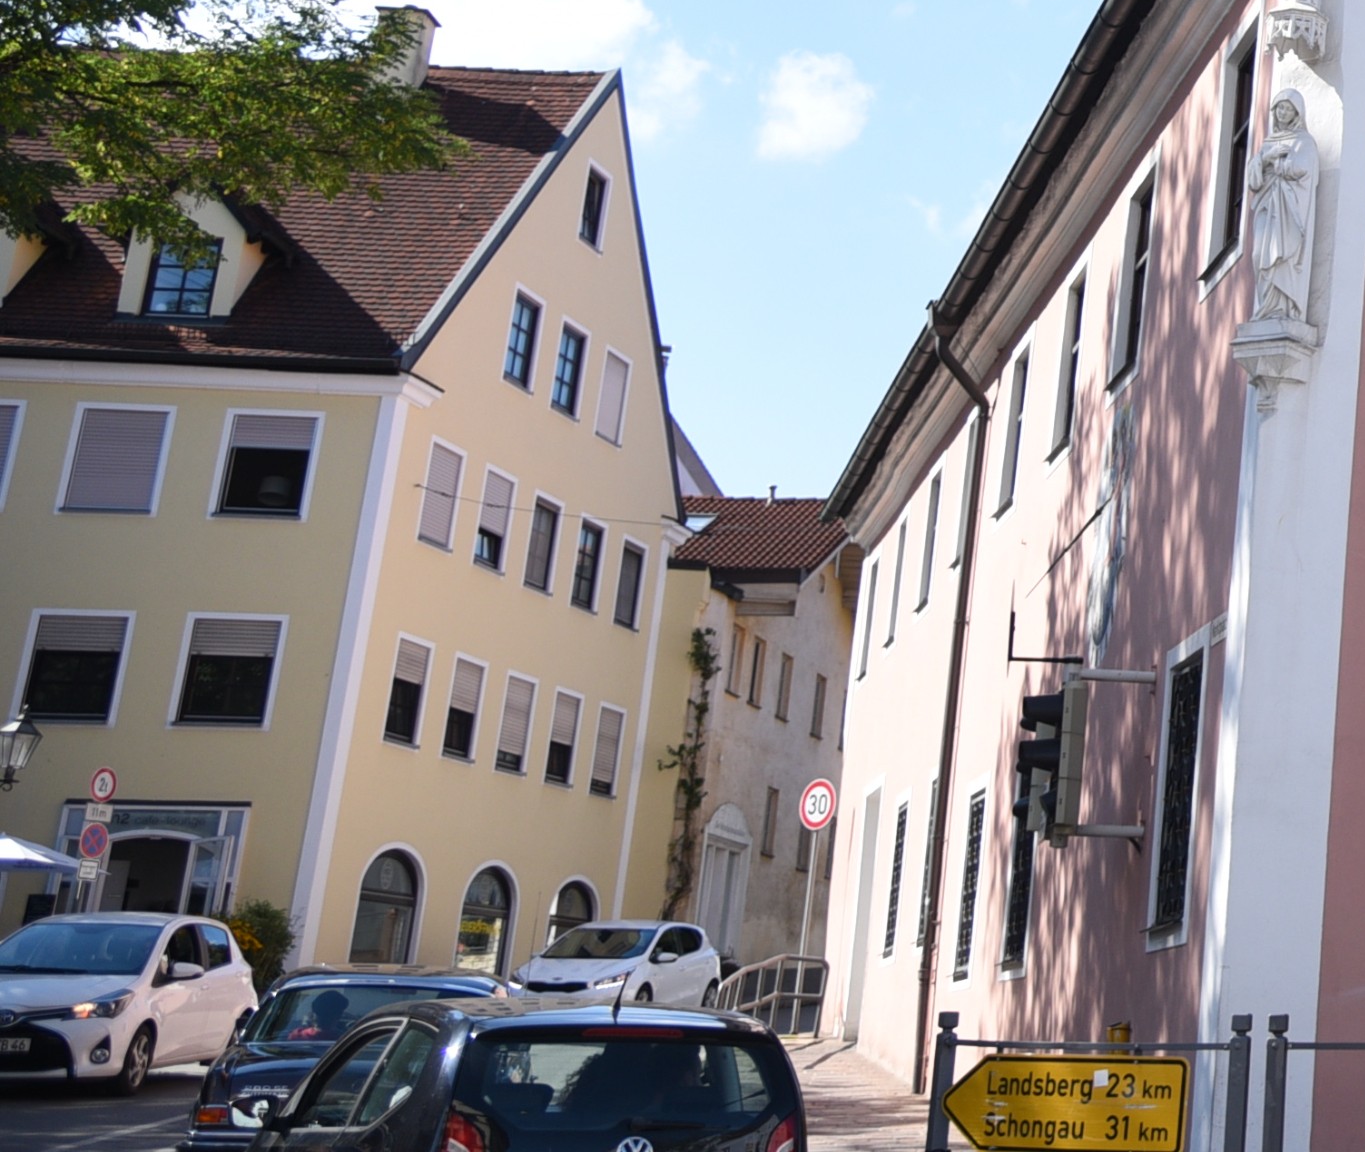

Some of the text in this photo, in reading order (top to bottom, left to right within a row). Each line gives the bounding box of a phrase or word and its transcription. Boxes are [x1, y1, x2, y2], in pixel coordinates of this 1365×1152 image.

[807, 794, 828, 816] 30
[986, 1070, 1172, 1104] Landsberg 23 km
[983, 1111, 1169, 1146] Schongau 31 km
